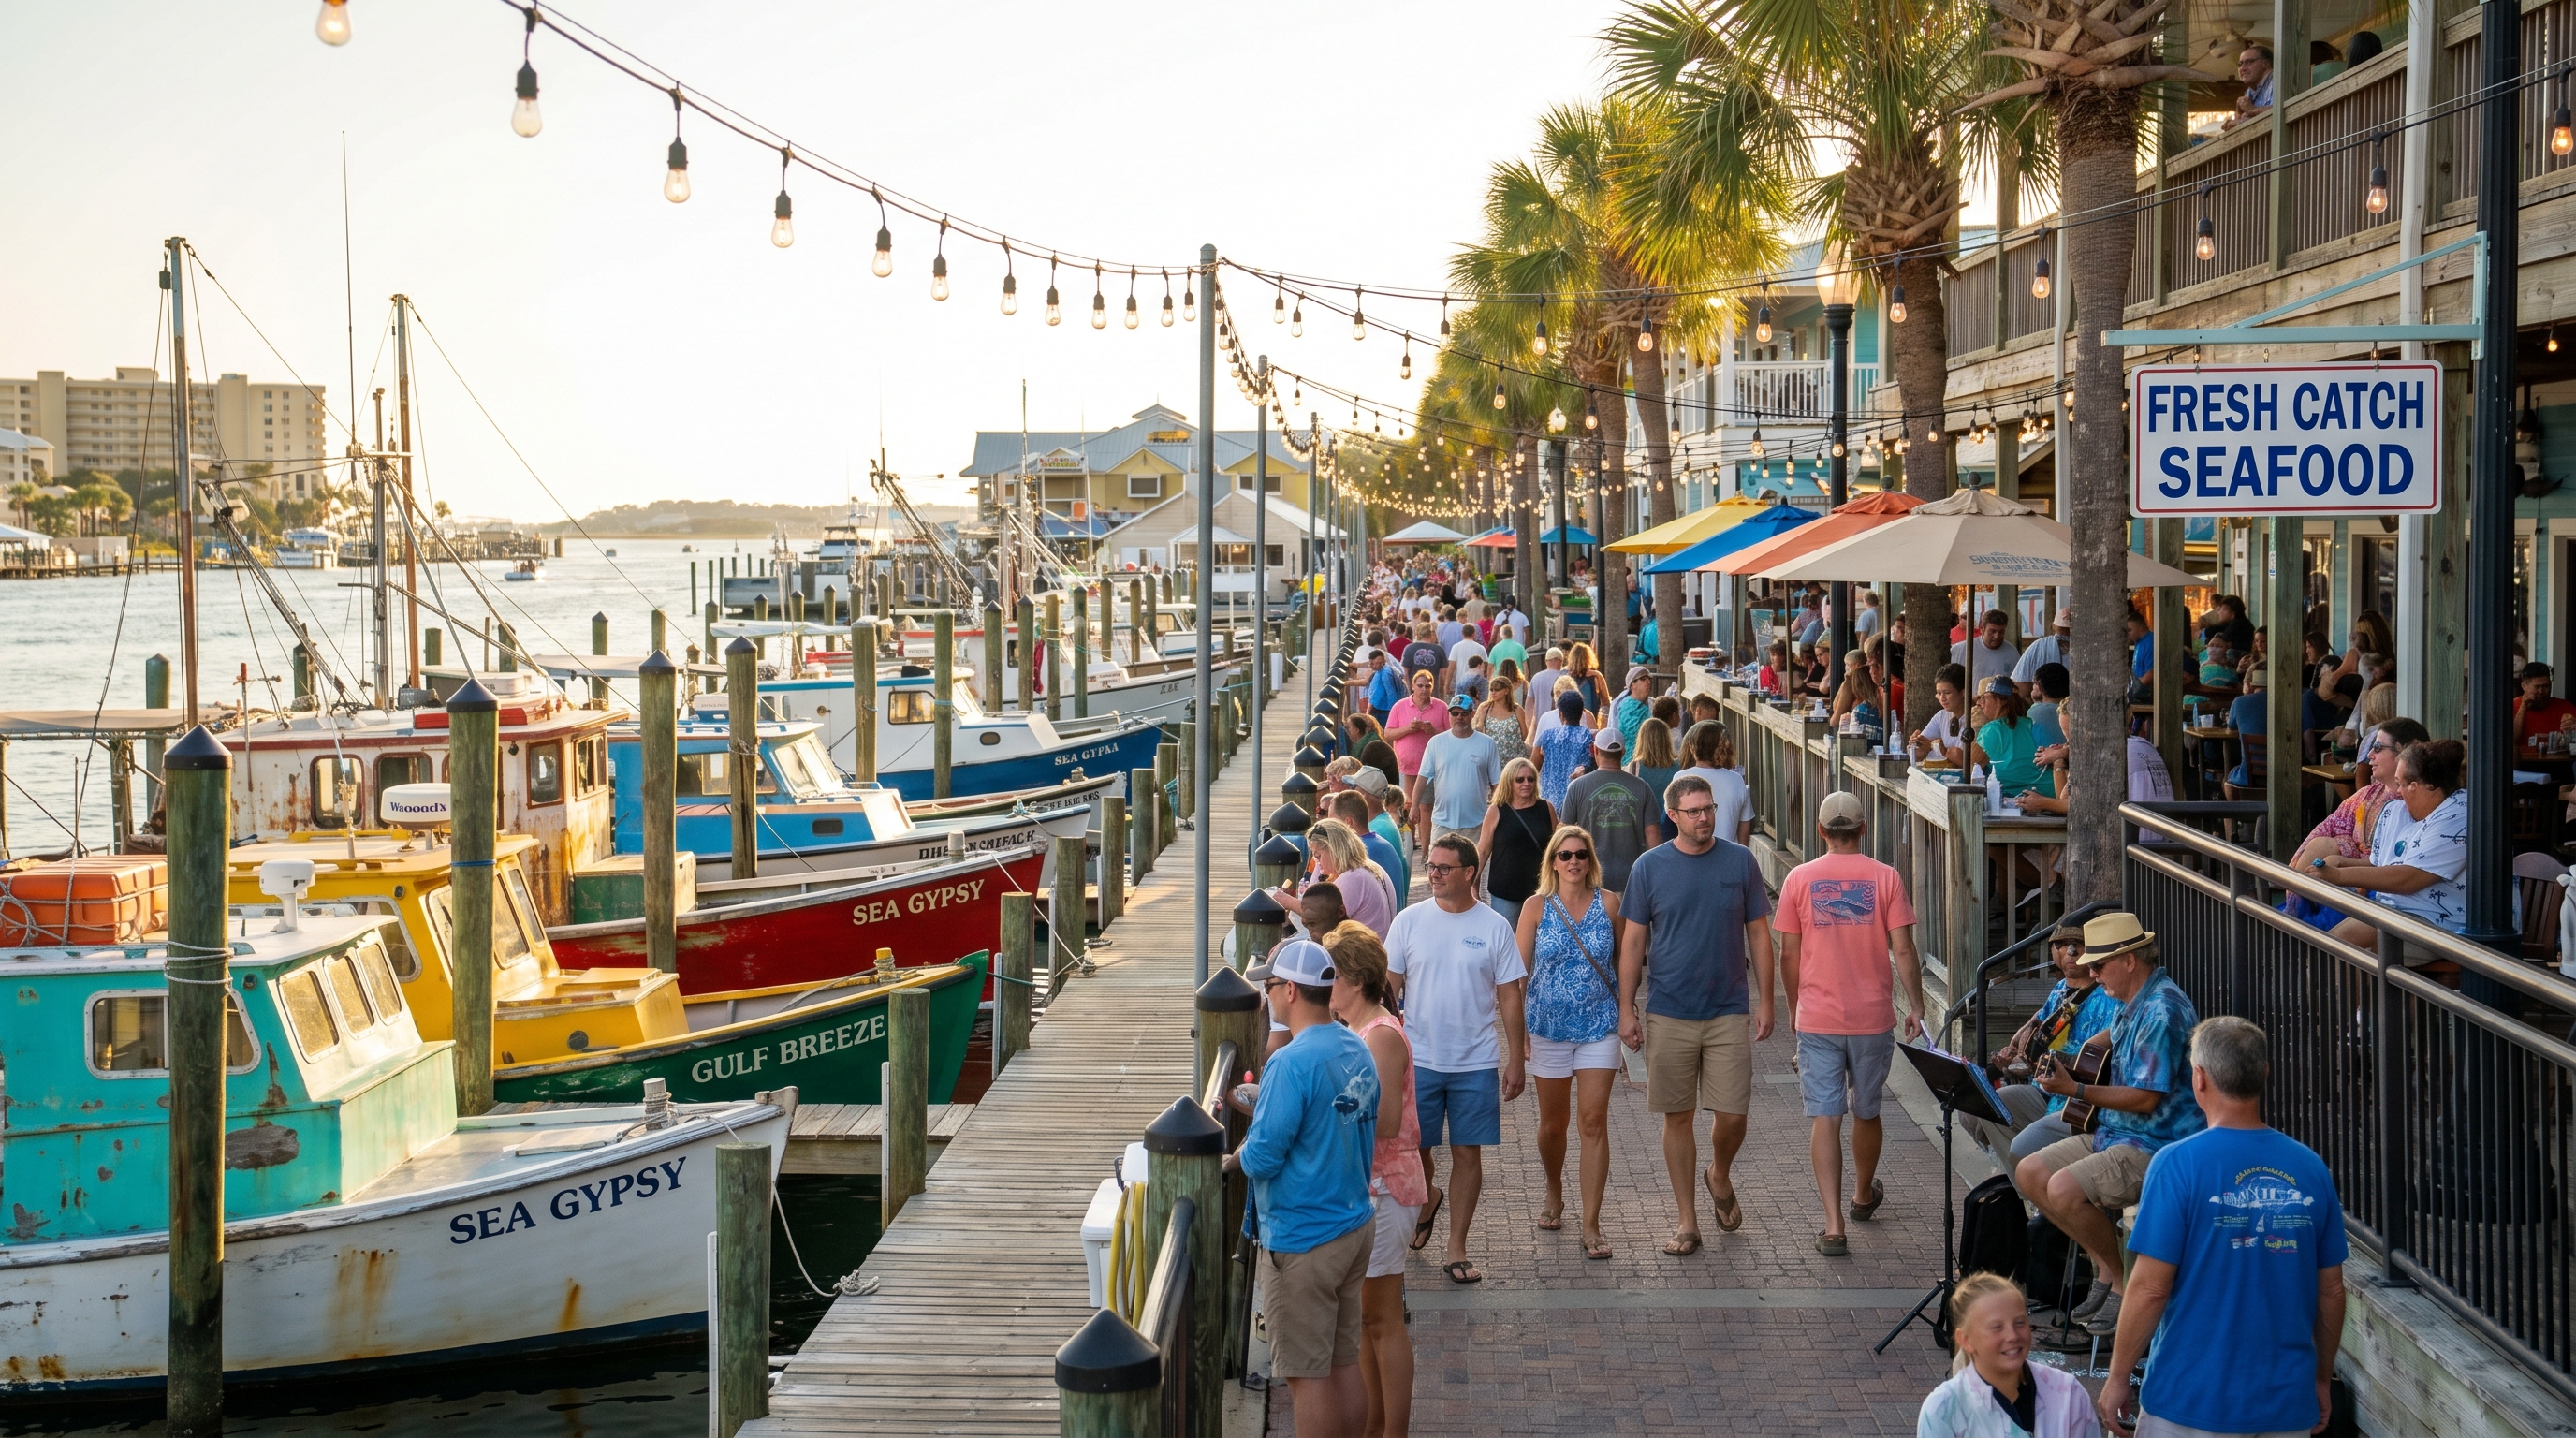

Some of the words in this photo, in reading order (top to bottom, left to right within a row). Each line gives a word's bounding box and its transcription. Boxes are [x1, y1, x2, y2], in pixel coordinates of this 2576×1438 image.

[2148, 383, 2278, 433] FRESH
[2292, 381, 2424, 431] CATCH
[2158, 443, 2414, 498] SEAFOOD
[1054, 753, 1078, 766] SEA
[852, 899, 901, 926] SEA
[907, 878, 985, 914] GYPSY
[691, 1046, 769, 1083] GULF
[779, 1014, 886, 1065] BREEZE
[449, 1200, 536, 1245] SEA
[549, 1155, 687, 1220] GYPSY
